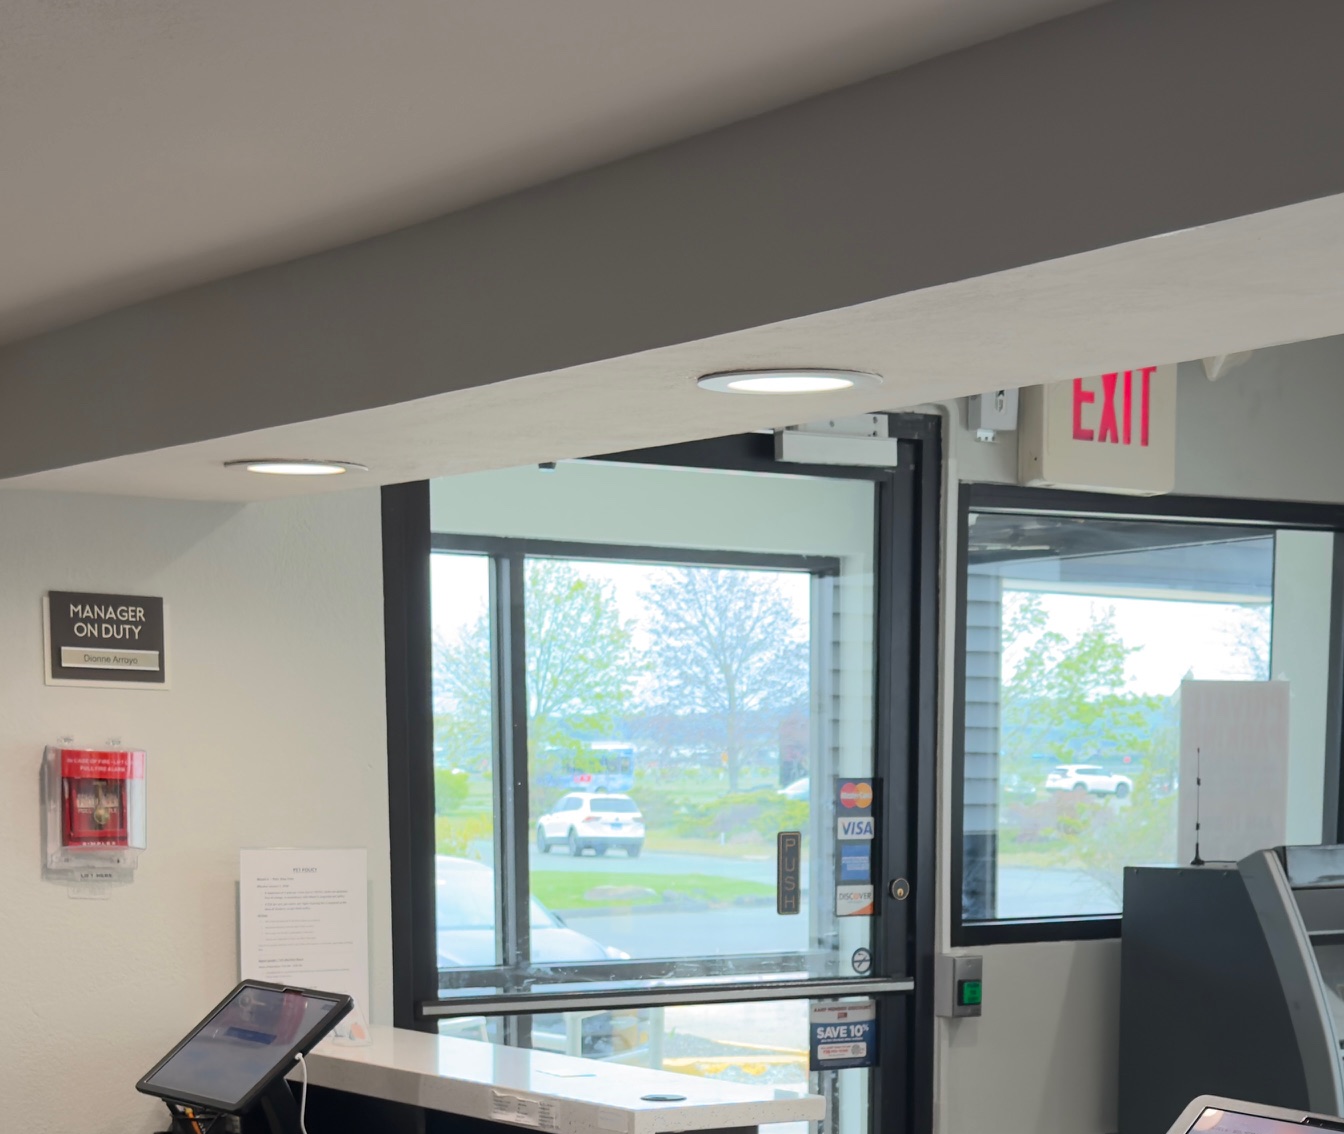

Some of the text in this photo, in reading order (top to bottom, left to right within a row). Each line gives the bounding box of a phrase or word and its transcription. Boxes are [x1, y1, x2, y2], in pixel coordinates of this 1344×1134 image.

[1072, 366, 1157, 447] EXIT
[70, 603, 146, 622] MANAGER
[74, 622, 142, 640] ON DUTY
[83, 654, 138, 666] Dionne Arroyo
[843, 821, 873, 836] VISA
[784, 838, 796, 909] PUSH
[839, 892, 872, 901] DISCOVER
[817, 1023, 869, 1039] SAVE 10%
